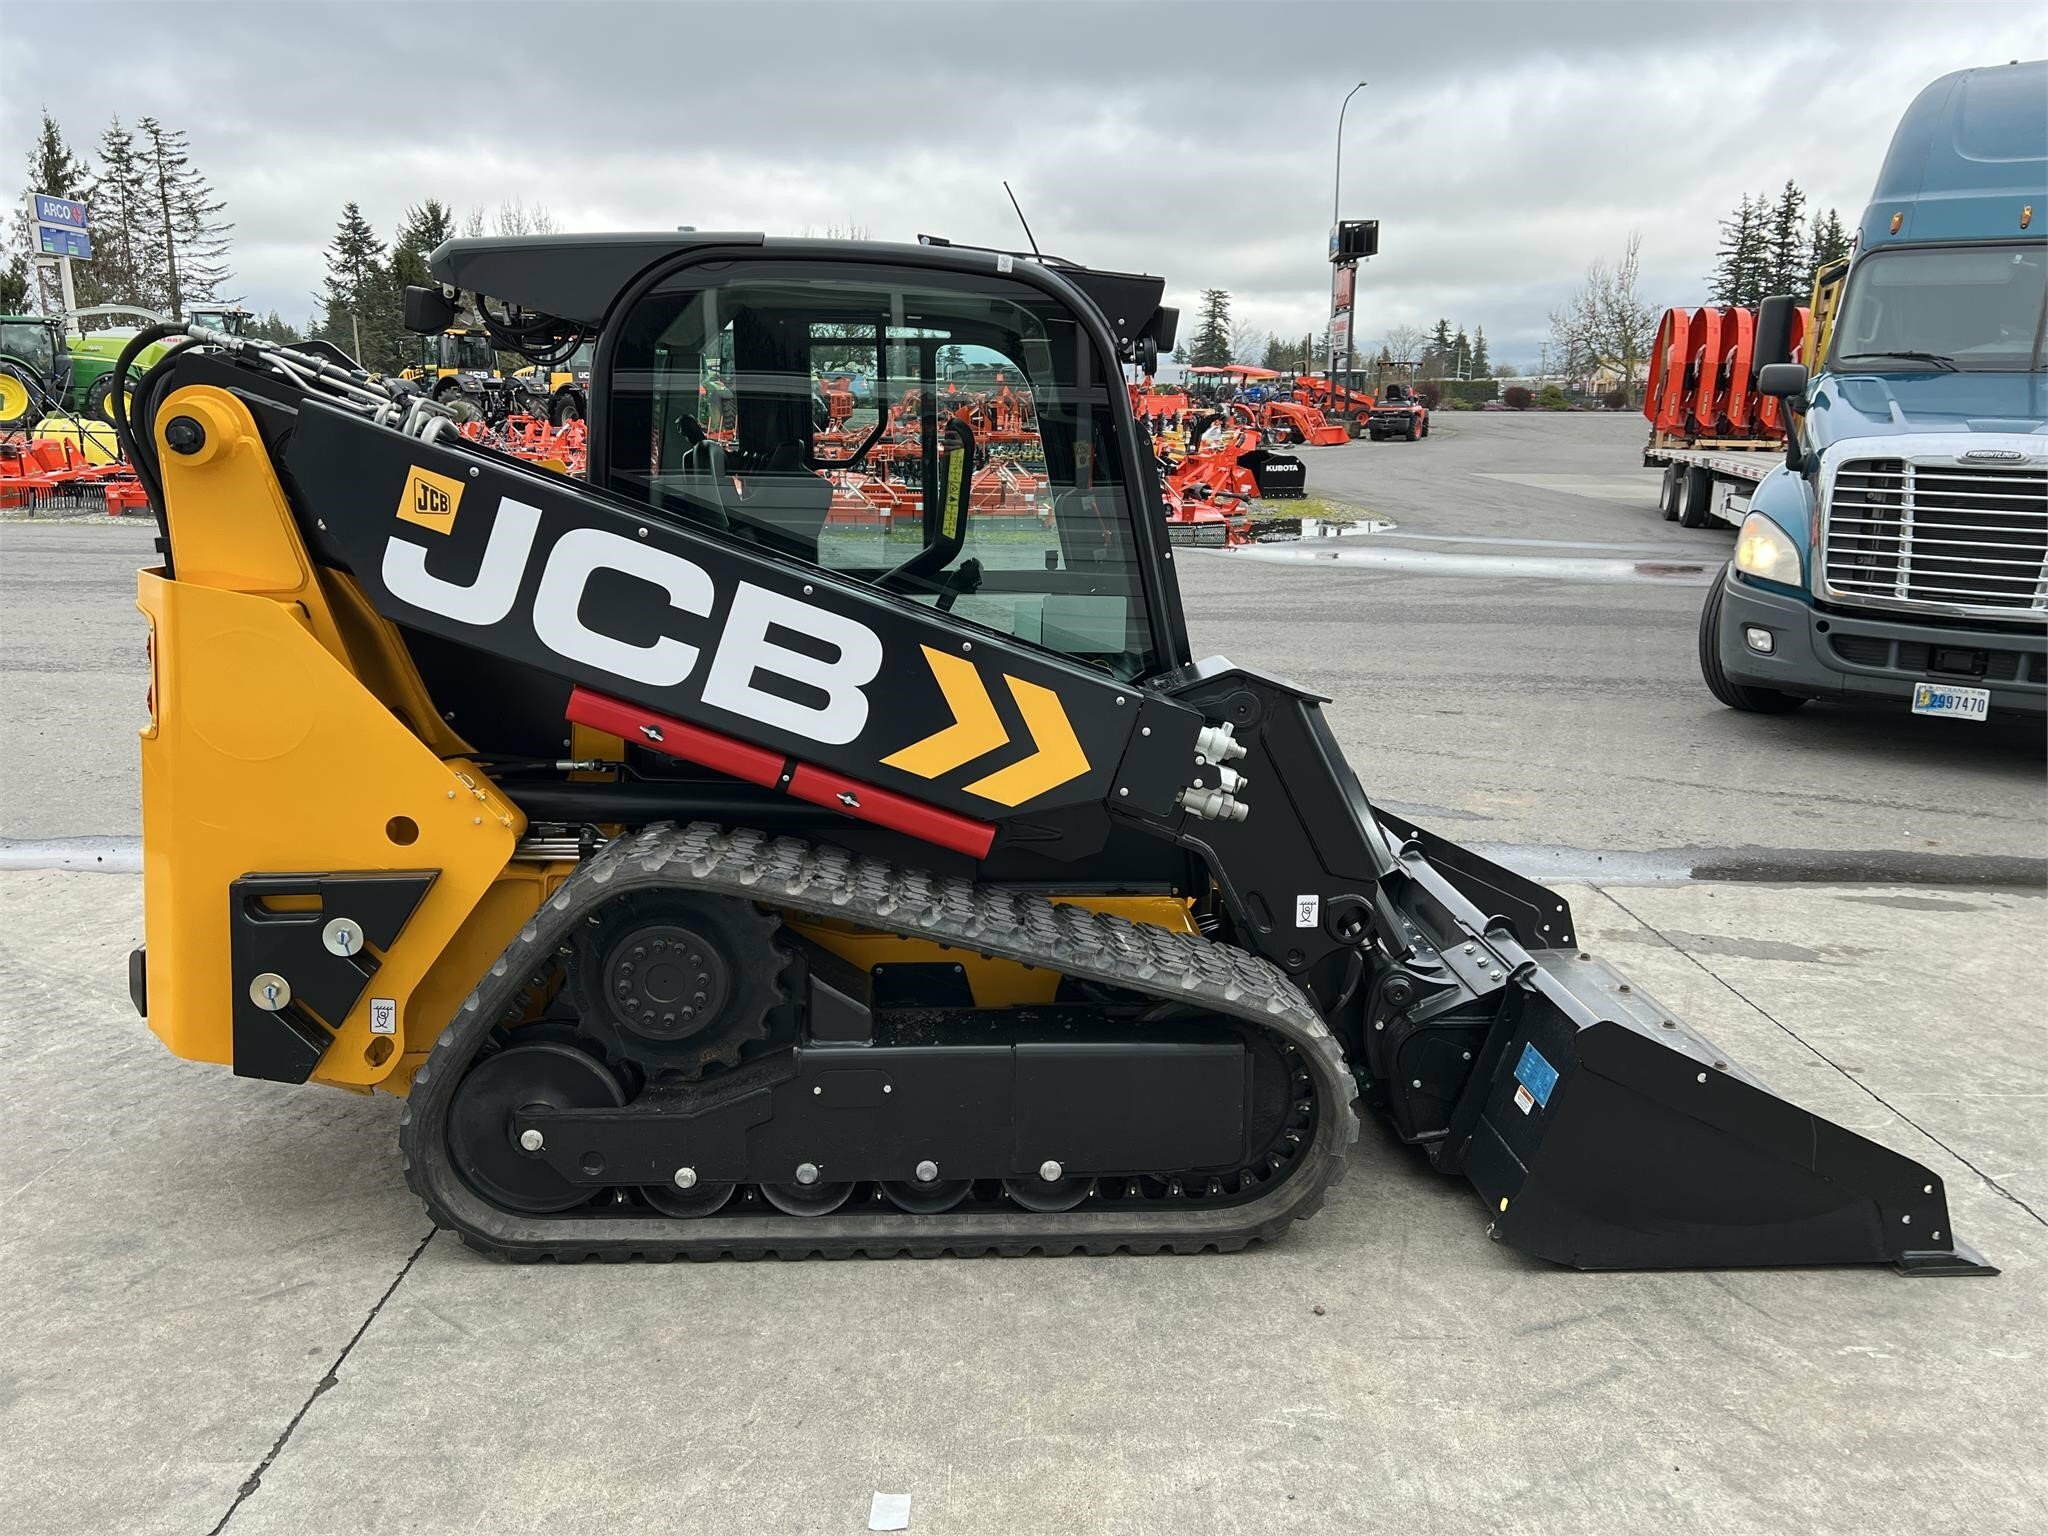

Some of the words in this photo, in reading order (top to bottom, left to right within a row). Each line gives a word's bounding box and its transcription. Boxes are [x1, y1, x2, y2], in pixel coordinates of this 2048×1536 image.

[44, 202, 70, 219] ARCO
[417, 483, 448, 512] JCB
[381, 496, 883, 745] JCB
[1930, 694, 1985, 712] 2997470
